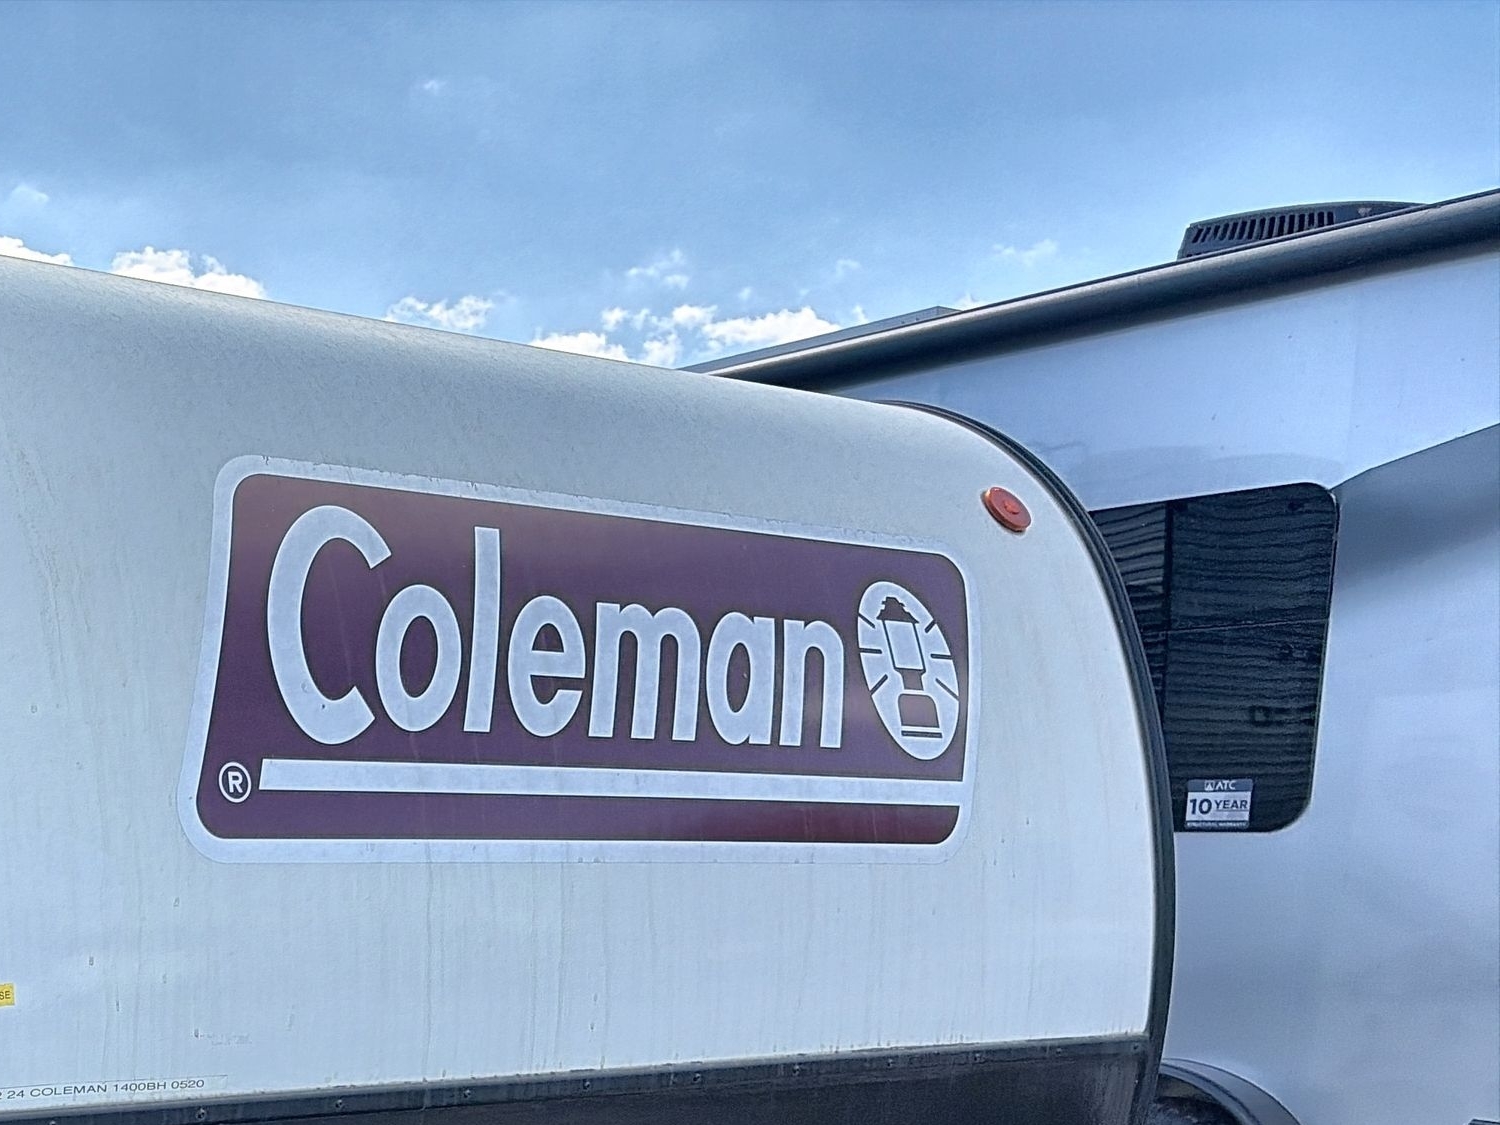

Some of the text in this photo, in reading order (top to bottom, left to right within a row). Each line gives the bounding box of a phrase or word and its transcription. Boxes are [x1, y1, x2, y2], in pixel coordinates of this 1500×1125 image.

[266, 504, 847, 750] Coleman
[1215, 780, 1237, 790] ATC
[1190, 798, 1248, 815] 10 YEAR
[7, 1090, 25, 1100] 24
[30, 1084, 108, 1098] COLEMAN
[113, 1080, 167, 1093] 1400BH
[171, 1079, 205, 1090] 0520
